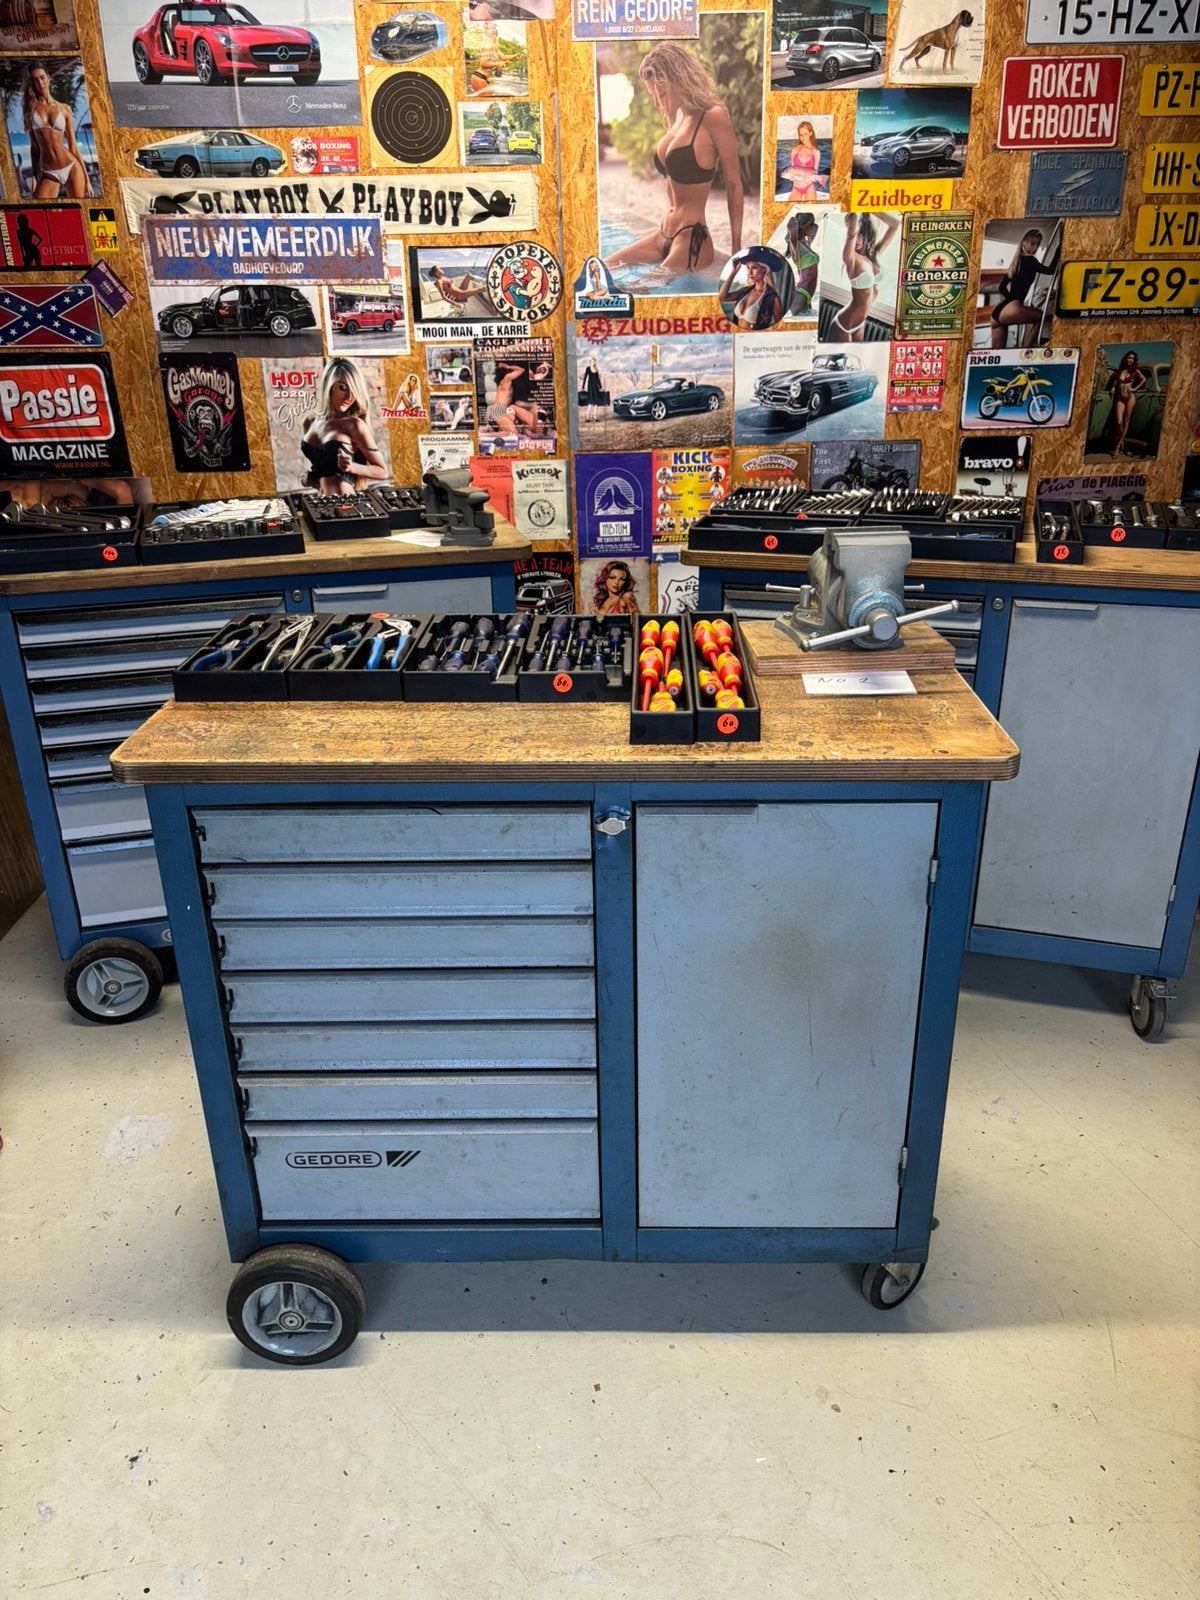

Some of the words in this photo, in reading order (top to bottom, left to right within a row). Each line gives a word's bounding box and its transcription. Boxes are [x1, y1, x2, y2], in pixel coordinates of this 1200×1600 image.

[577, 0, 617, 23] REIN
[624, 0, 693, 22] GEDORE
[1058, 0, 1200, 35] 15-HZ-X
[1028, 62, 1100, 99] ROKEN
[1007, 103, 1114, 139] VERBODEN
[352, 181, 463, 228] PLAYBOY
[857, 189, 943, 209] Zuidberg
[1148, 211, 1200, 247] JX-D
[41, 245, 86, 256] DISTRICT
[154, 226, 375, 258] NIEUWEMEERDIJK
[233, 262, 305, 275] BADHOEVEDORP
[494, 244, 557, 275] POPEYE
[496, 297, 551, 321] SALOR
[482, 325, 494, 336] DE
[497, 324, 529, 336] KARRE
[616, 317, 732, 336] ZUIDBERG
[477, 345, 551, 353] TOURNAMENT
[270, 371, 317, 387] HOT
[0, 374, 99, 423] Passie
[272, 390, 305, 398] 2020
[276, 392, 317, 431] Girls
[12, 443, 109, 461] MAGAZINE
[673, 451, 713, 465] KICK
[54, 461, 111, 469] WWW.PASSIE.NL
[516, 467, 562, 480] KICKBOX
[671, 465, 713, 473] BOXING
[813, 467, 835, 475] Brand
[1037, 478, 1080, 495] Ciao
[1082, 477, 1097, 489] de
[1099, 475, 1146, 488] PIAGGIO
[675, 585, 699, 593] AFC
[293, 1154, 374, 1165] GEDORE
